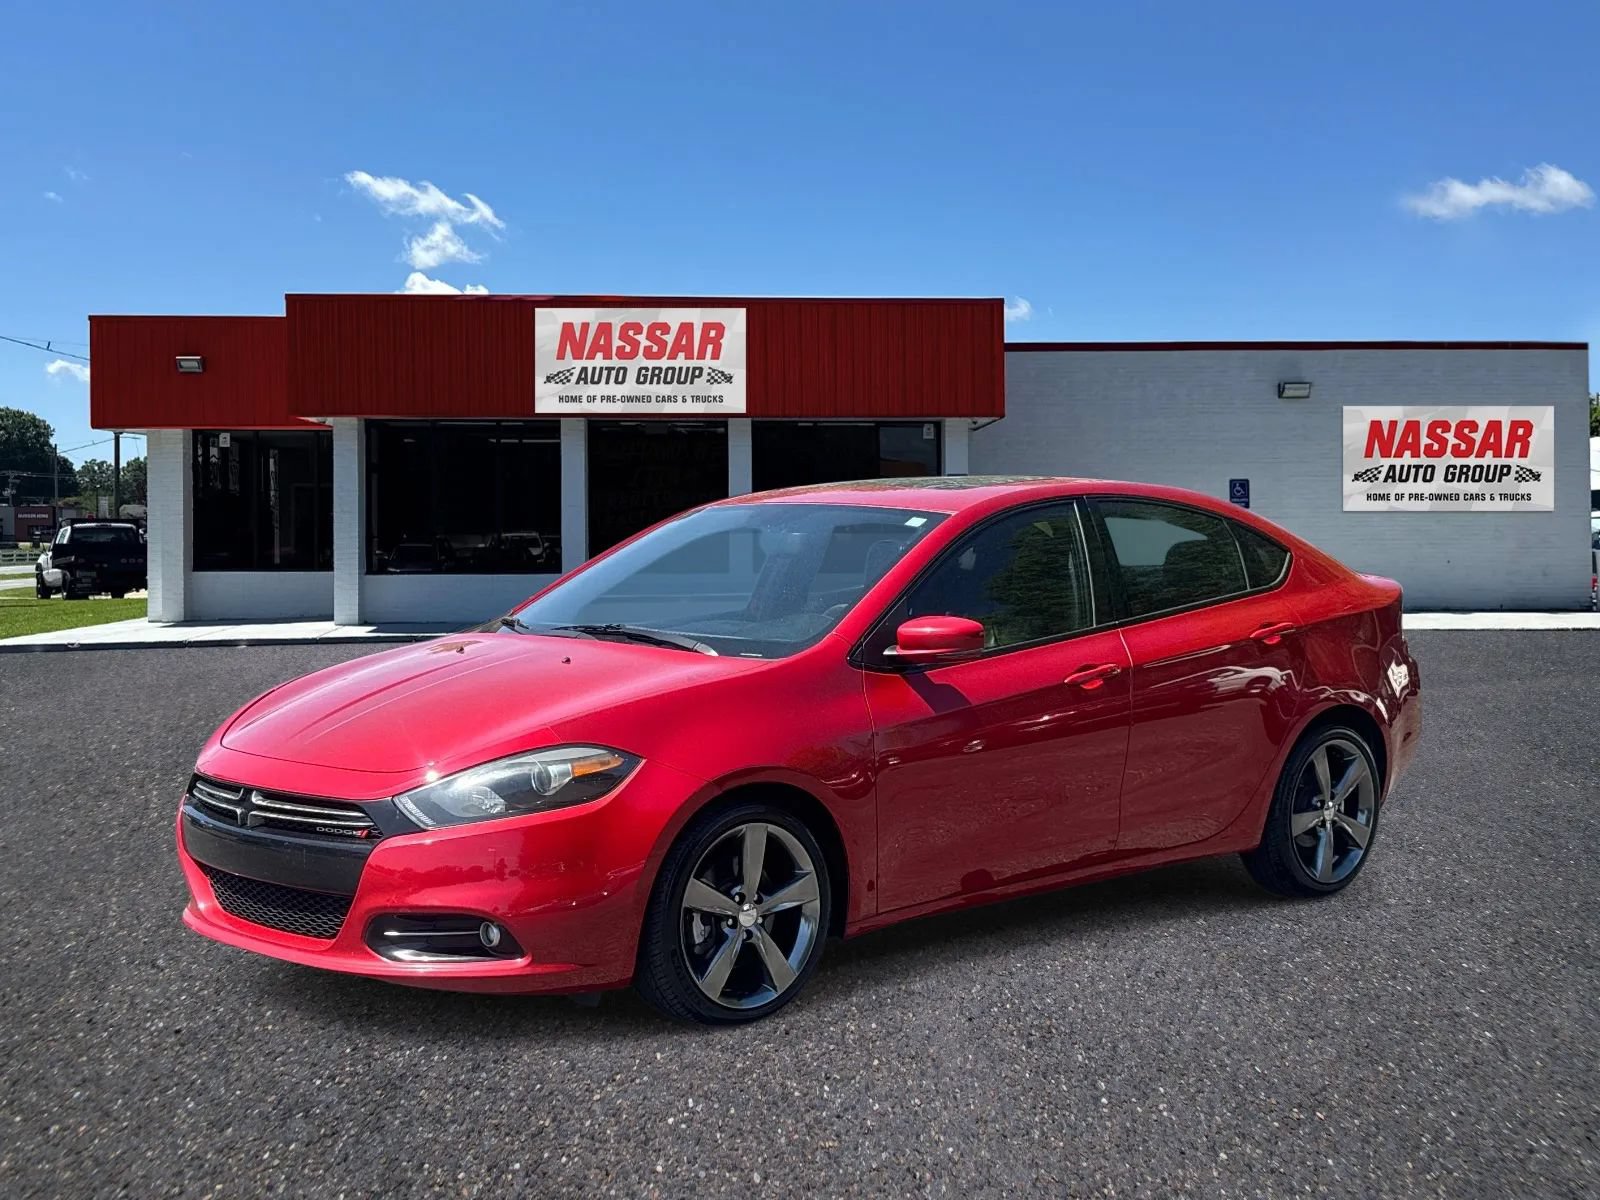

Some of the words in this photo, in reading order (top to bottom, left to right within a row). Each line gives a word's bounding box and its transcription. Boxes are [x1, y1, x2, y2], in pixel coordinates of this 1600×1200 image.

[556, 322, 725, 360] NASSAR
[575, 367, 628, 385] AUTO
[636, 367, 704, 385] GROUP
[559, 395, 582, 403] HOME
[587, 395, 596, 403] OF
[601, 395, 651, 403] PRE-OWNED
[656, 395, 678, 403] CARS
[682, 395, 687, 403] &
[691, 395, 723, 403] TRUCKS
[1364, 420, 1533, 458] NASSAR
[1383, 464, 1436, 483] AUTO
[1443, 464, 1512, 483] GROUP
[1367, 493, 1391, 501] HOME
[1395, 493, 1405, 501] OF
[1409, 493, 1460, 501] PRE-OWNED
[1464, 493, 1486, 501] CARS
[1490, 493, 1495, 501] &
[1498, 493, 1531, 501] TRUCKS
[316, 826, 362, 836] DODGE
